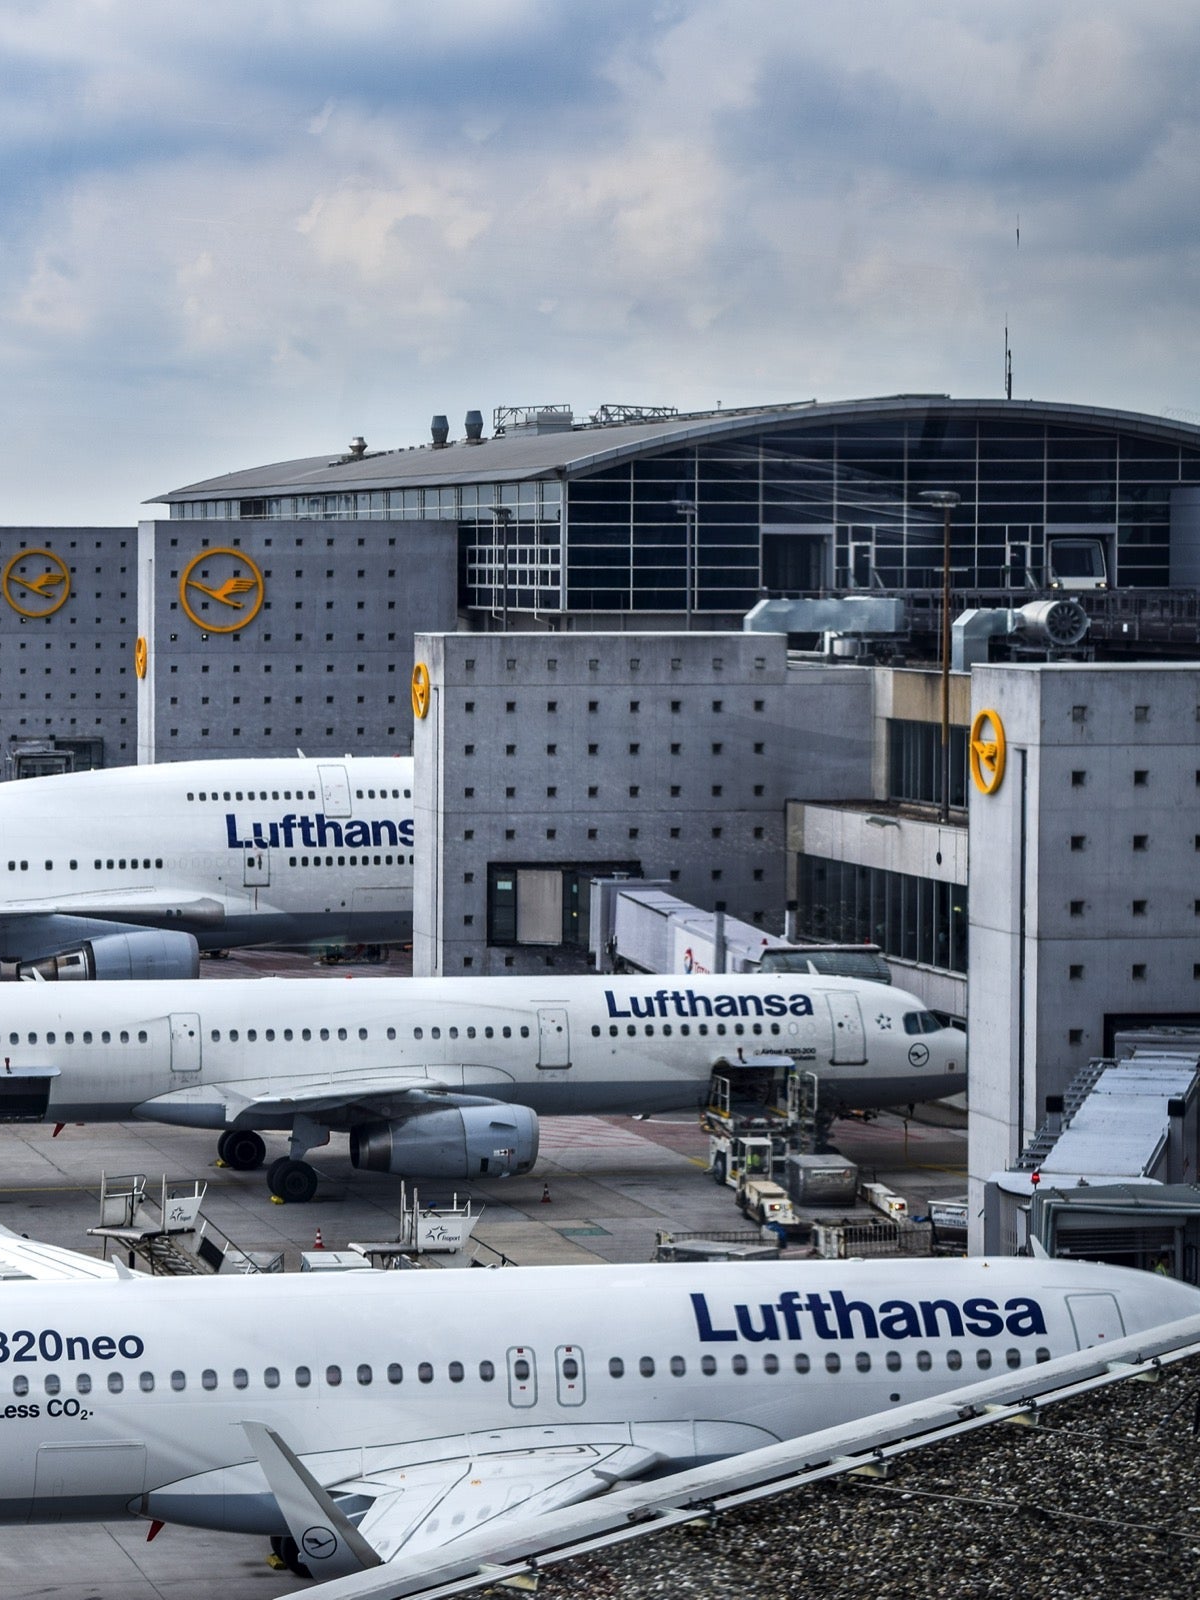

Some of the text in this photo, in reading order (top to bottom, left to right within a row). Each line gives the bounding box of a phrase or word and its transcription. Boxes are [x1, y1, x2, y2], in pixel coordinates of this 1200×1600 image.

[225, 813, 415, 849] Lufthans
[604, 989, 814, 1018] Lufthansa
[690, 1291, 1049, 1342] Lufthansa
